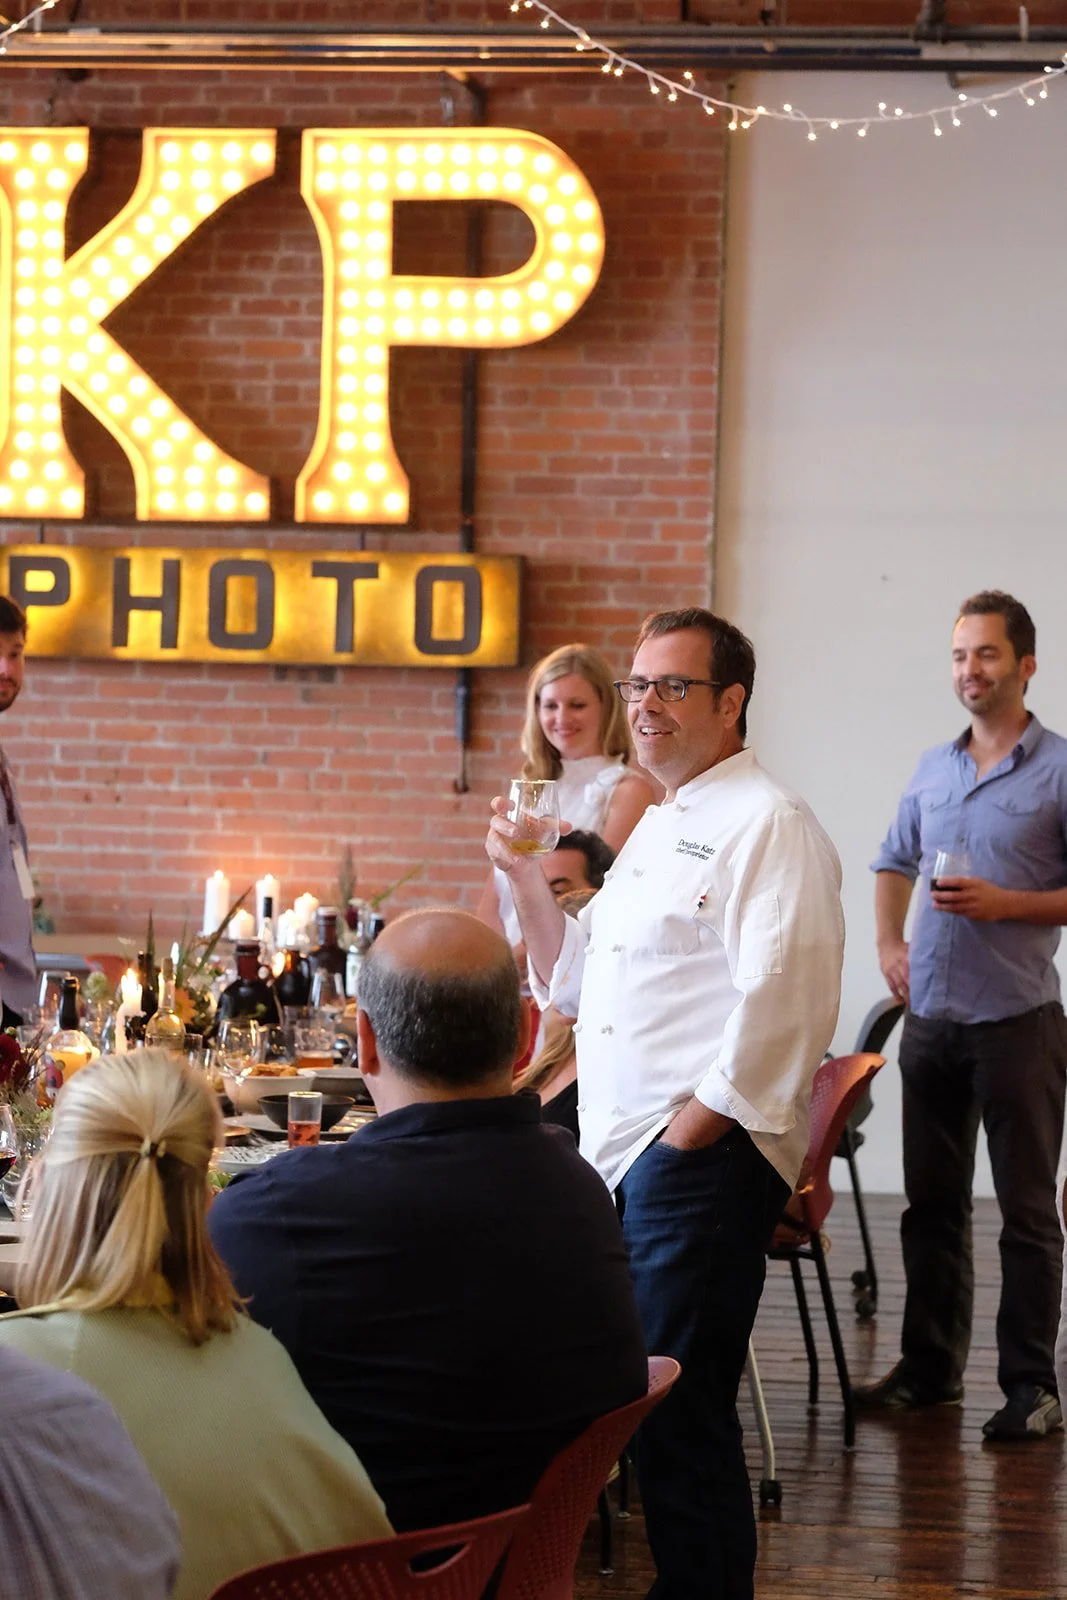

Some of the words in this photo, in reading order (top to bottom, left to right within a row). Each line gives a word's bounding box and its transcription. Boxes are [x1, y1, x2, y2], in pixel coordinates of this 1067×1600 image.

[9, 556, 483, 656] PHOTO
[678, 838, 701, 850] Douglas
[700, 844, 716, 855] Katz
